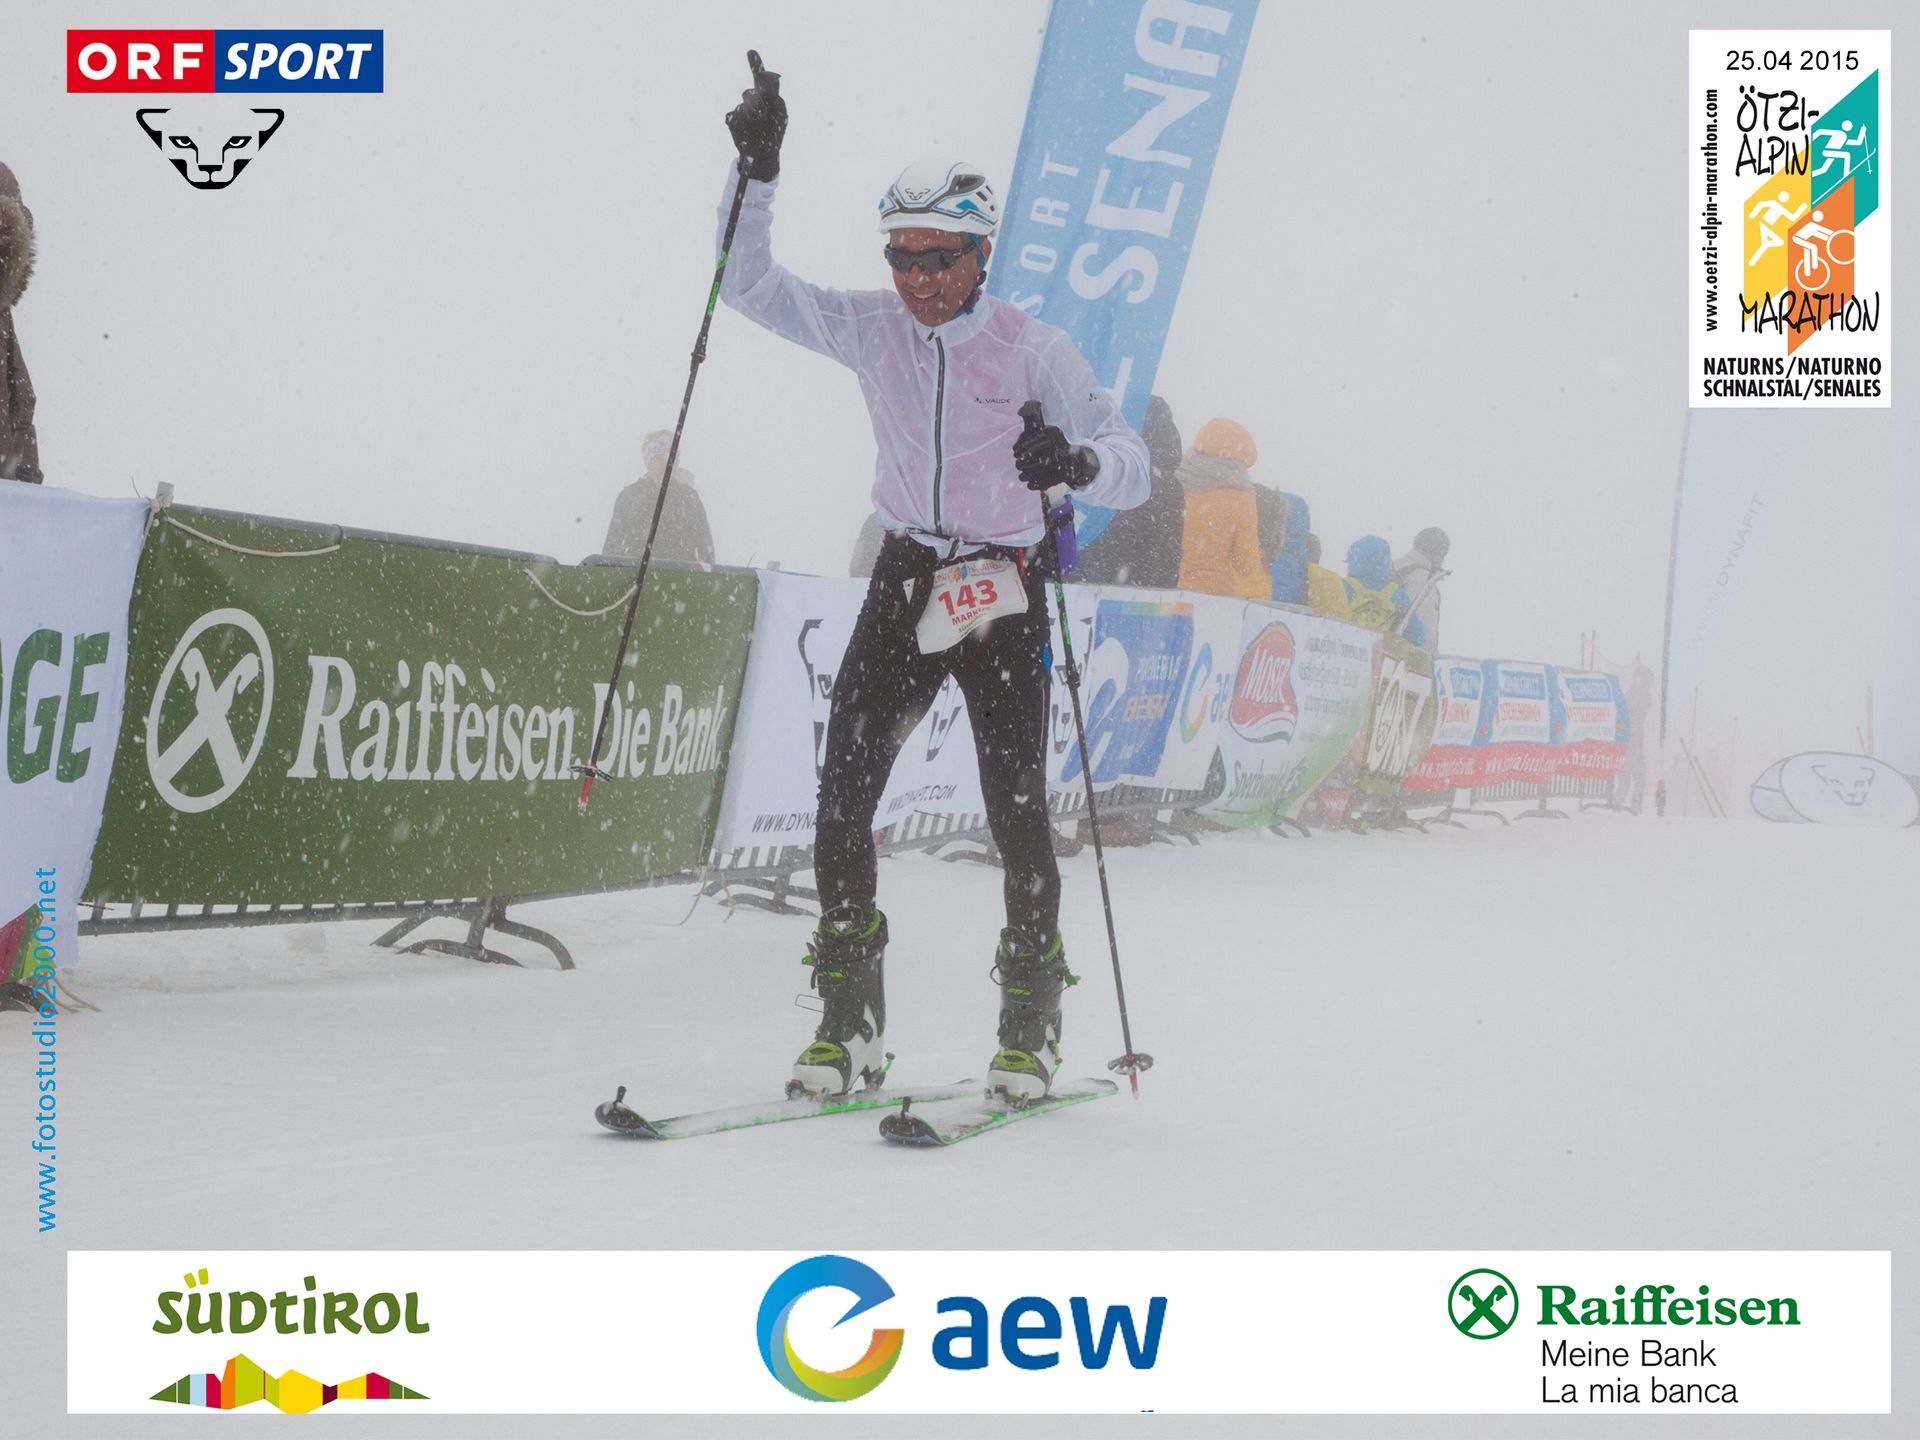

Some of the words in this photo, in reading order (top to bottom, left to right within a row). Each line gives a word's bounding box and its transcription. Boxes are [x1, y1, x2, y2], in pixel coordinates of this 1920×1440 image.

[938, 579, 998, 616] 143
[0, 628, 110, 784] GE
[592, 680, 651, 779] Die
